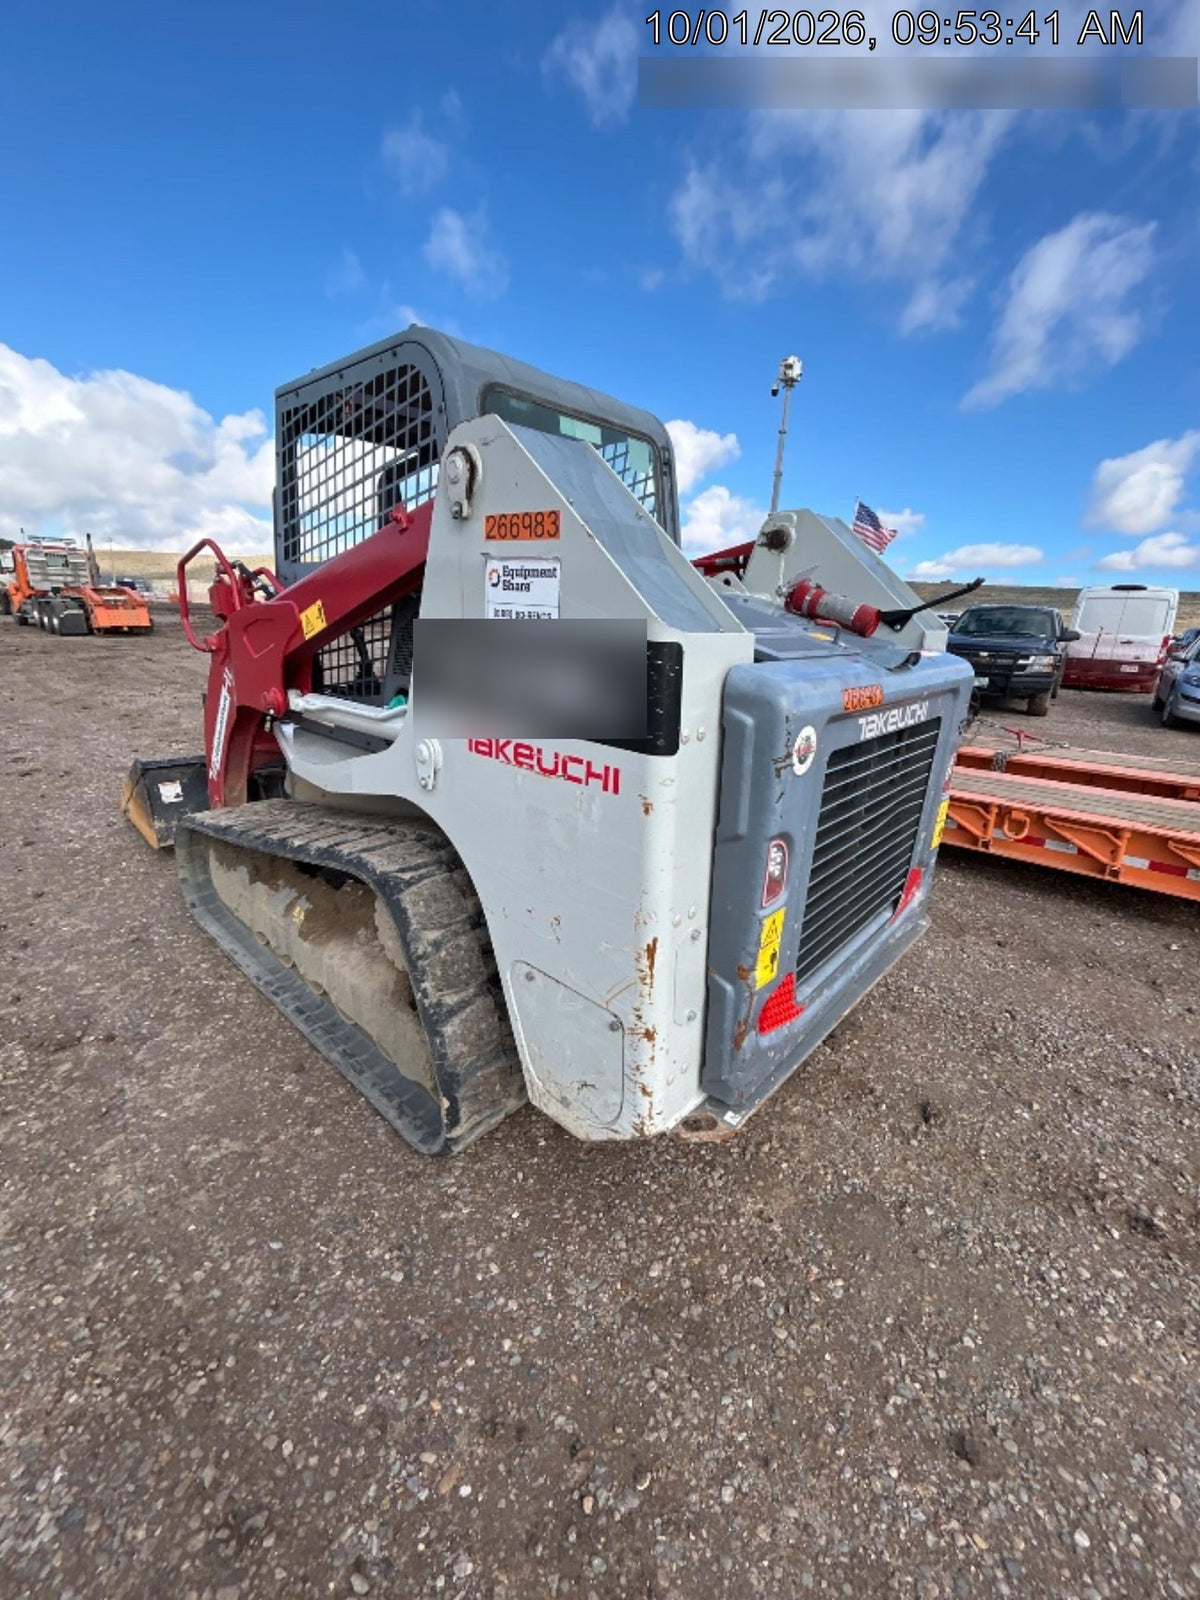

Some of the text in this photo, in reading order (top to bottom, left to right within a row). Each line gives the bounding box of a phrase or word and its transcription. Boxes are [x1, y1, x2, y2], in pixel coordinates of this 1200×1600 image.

[485, 510, 559, 539] 266983
[502, 565, 558, 580] Equipment
[502, 579, 531, 592] Share
